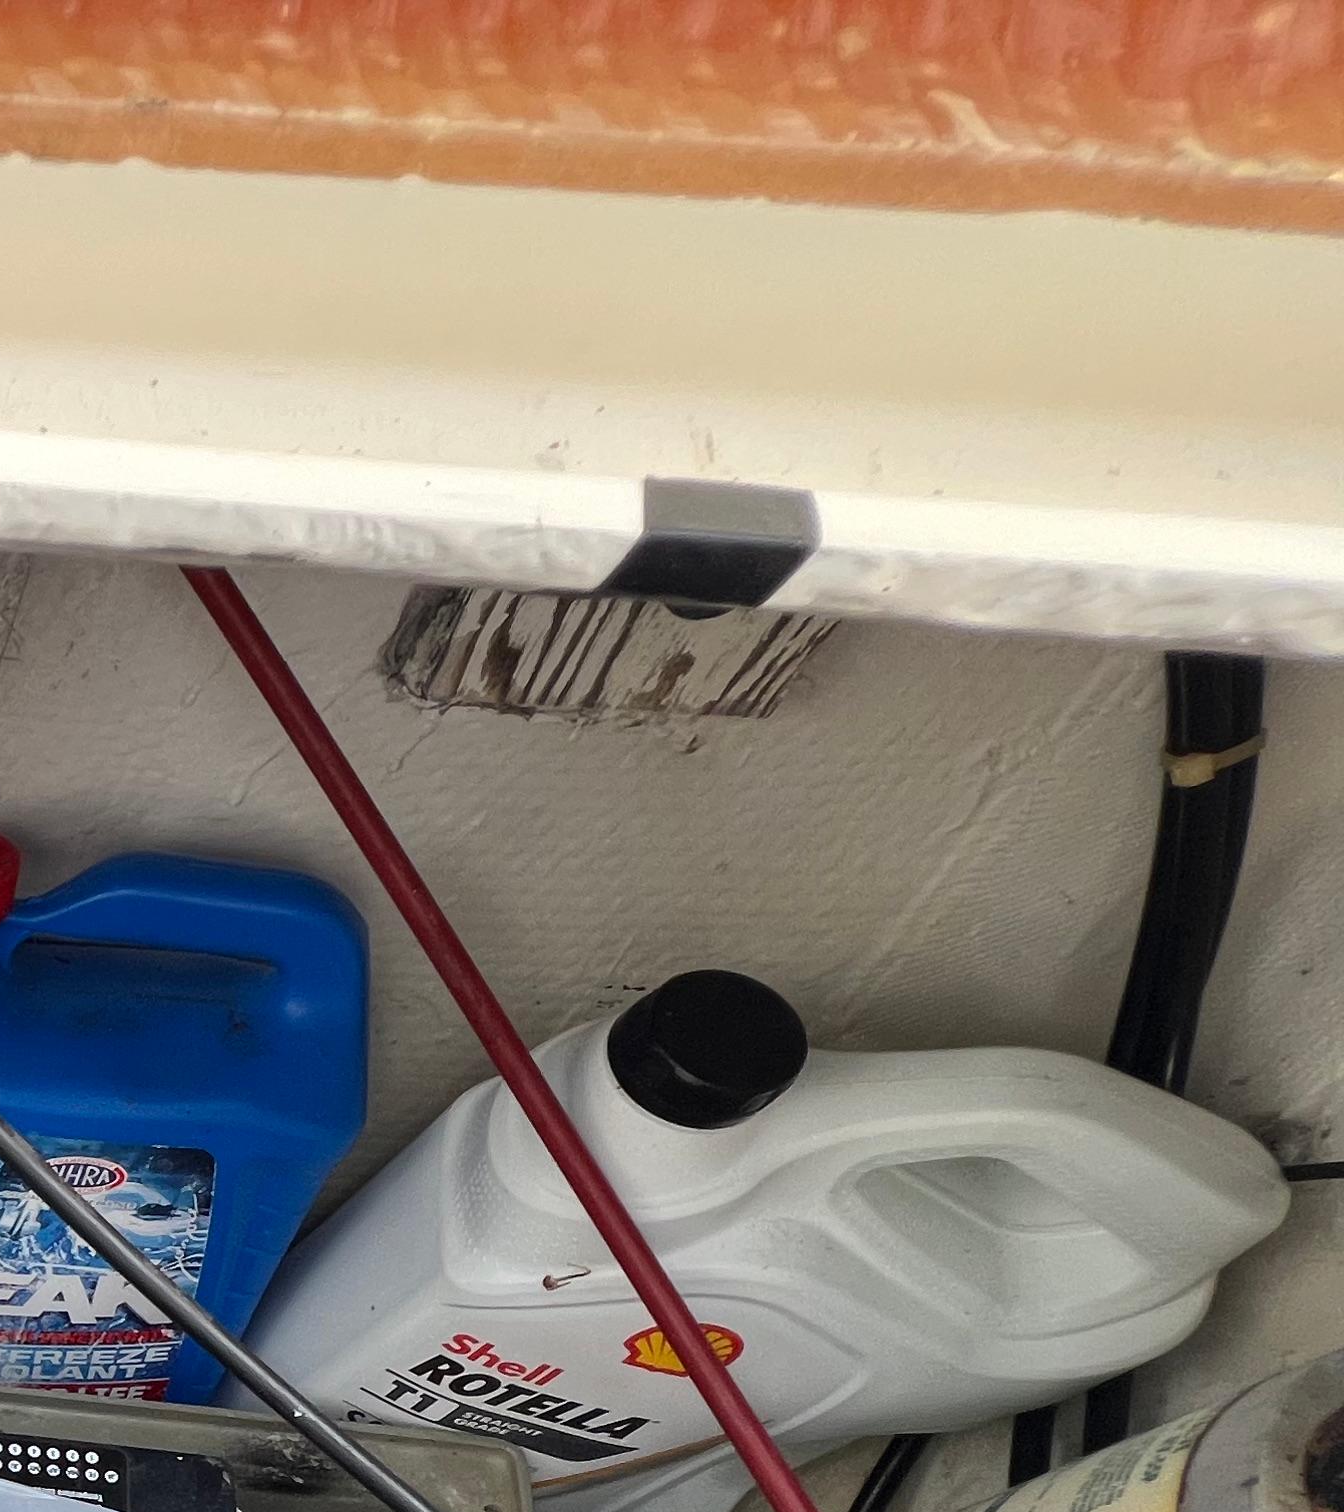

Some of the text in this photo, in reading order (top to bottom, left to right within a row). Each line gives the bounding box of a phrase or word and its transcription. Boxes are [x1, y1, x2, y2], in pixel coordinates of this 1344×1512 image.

[441, 1334, 566, 1386] Shell
[385, 1380, 433, 1412] T1
[409, 1354, 650, 1440] ROTELLA
[454, 1418, 510, 1434] GRADE
[462, 1412, 544, 1436] STRAIGHT
